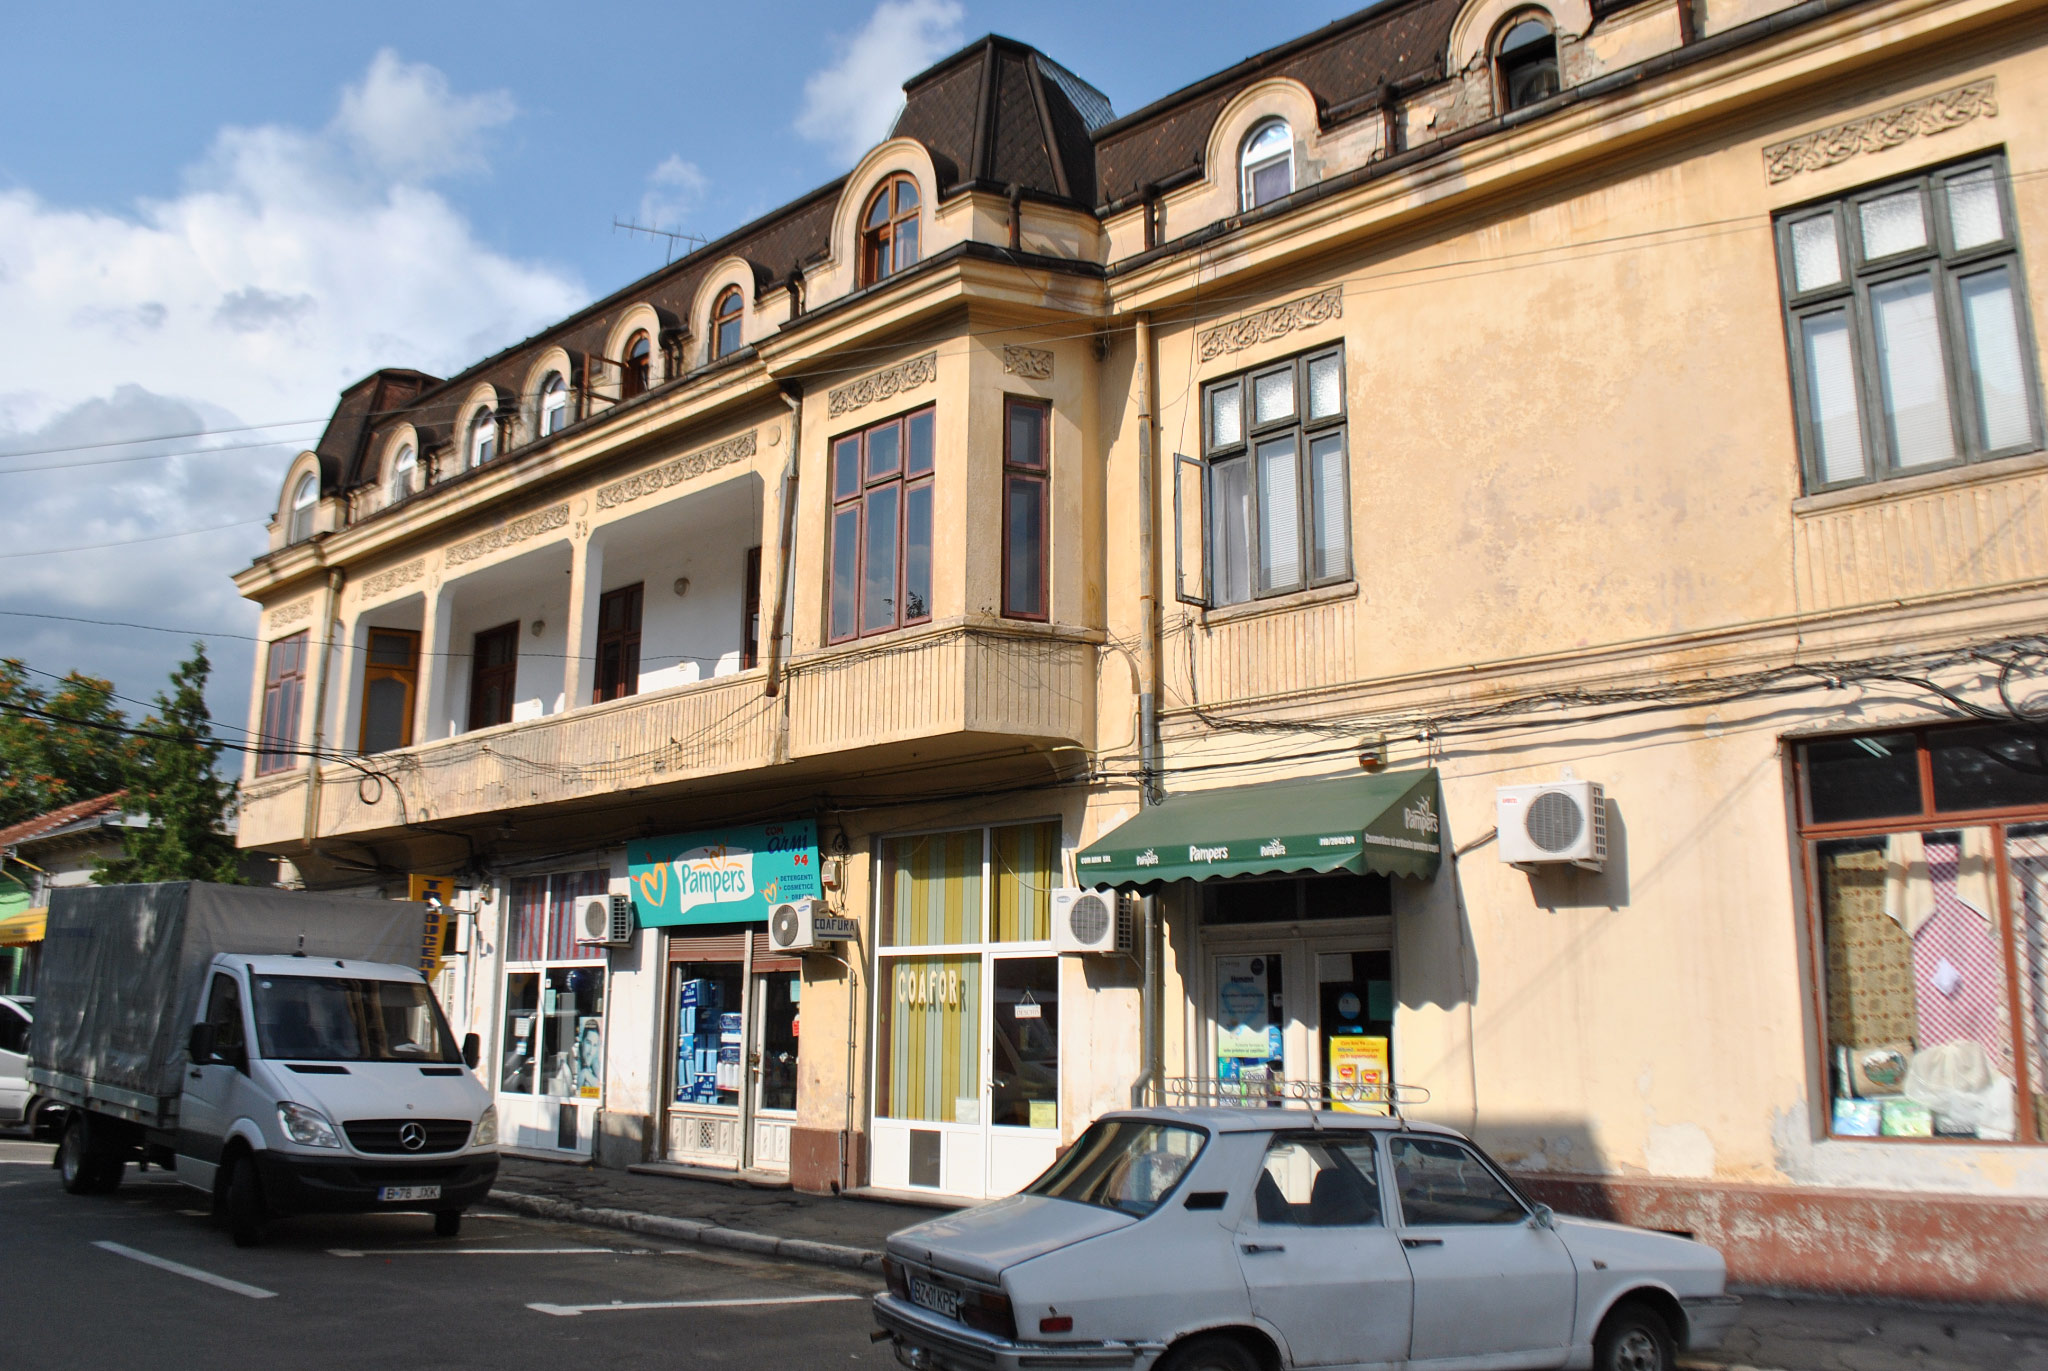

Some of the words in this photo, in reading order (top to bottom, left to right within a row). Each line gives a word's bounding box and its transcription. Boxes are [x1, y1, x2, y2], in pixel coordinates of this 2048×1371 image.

[1404, 807, 1439, 837] Pampers
[765, 826, 784, 836] COM
[1189, 845, 1229, 864] Pampers
[1260, 845, 1286, 858] Pampers
[794, 854, 808, 866] 94
[1136, 854, 1159, 867] Pampers
[682, 864, 745, 902] Pampers
[780, 874, 813, 882] DETERGENTI
[783, 883, 814, 891] COSMETICE
[814, 918, 855, 931] COAFURA
[898, 969, 957, 1004] COAFOR
[386, 1188, 395, 1199] B
[915, 1280, 926, 1303] BZ
